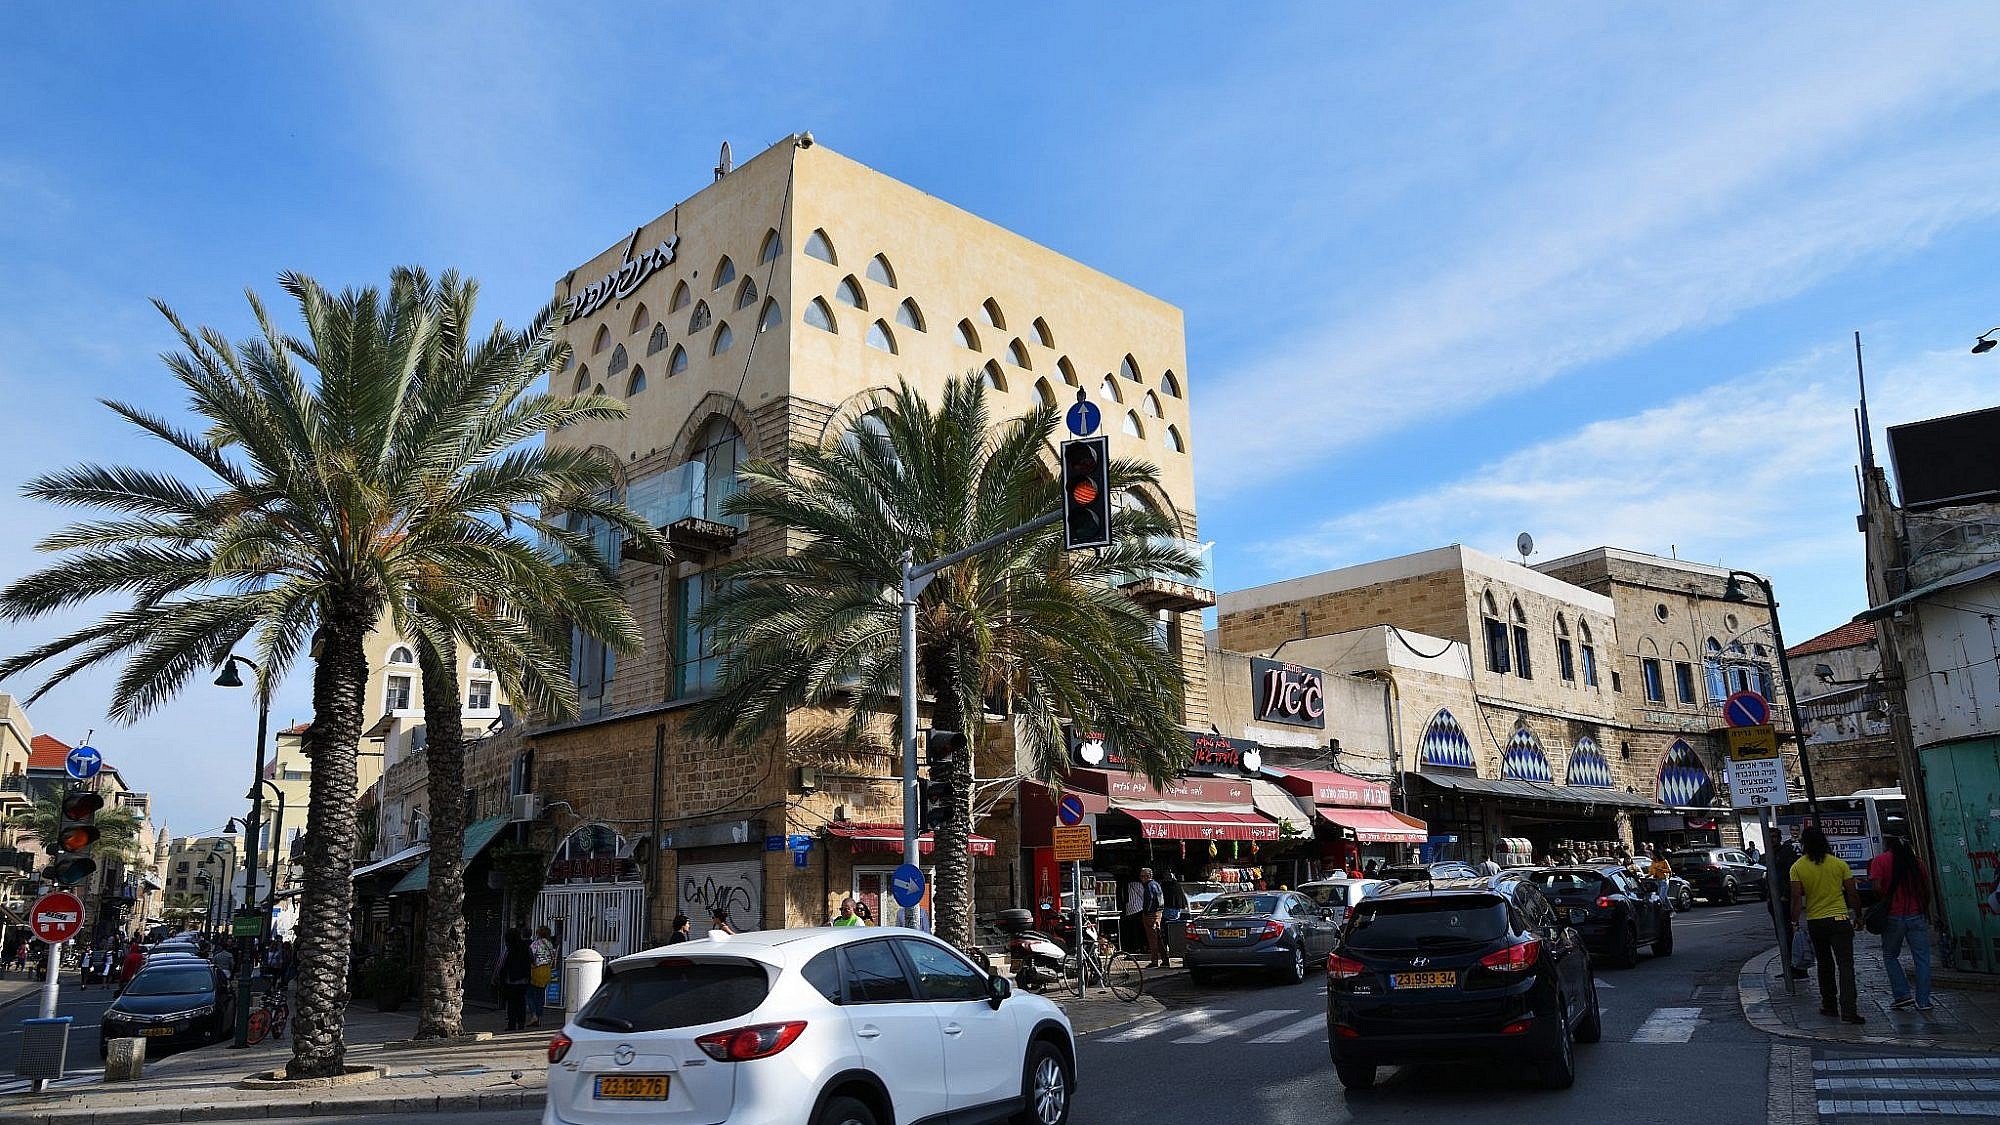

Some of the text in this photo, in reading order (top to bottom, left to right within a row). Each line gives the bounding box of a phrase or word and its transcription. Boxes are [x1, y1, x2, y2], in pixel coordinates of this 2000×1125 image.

[1735, 762, 1757, 770] אכיפת
[1735, 769, 1777, 779] חניה מוגברת
[1740, 777, 1774, 786] באמצעים
